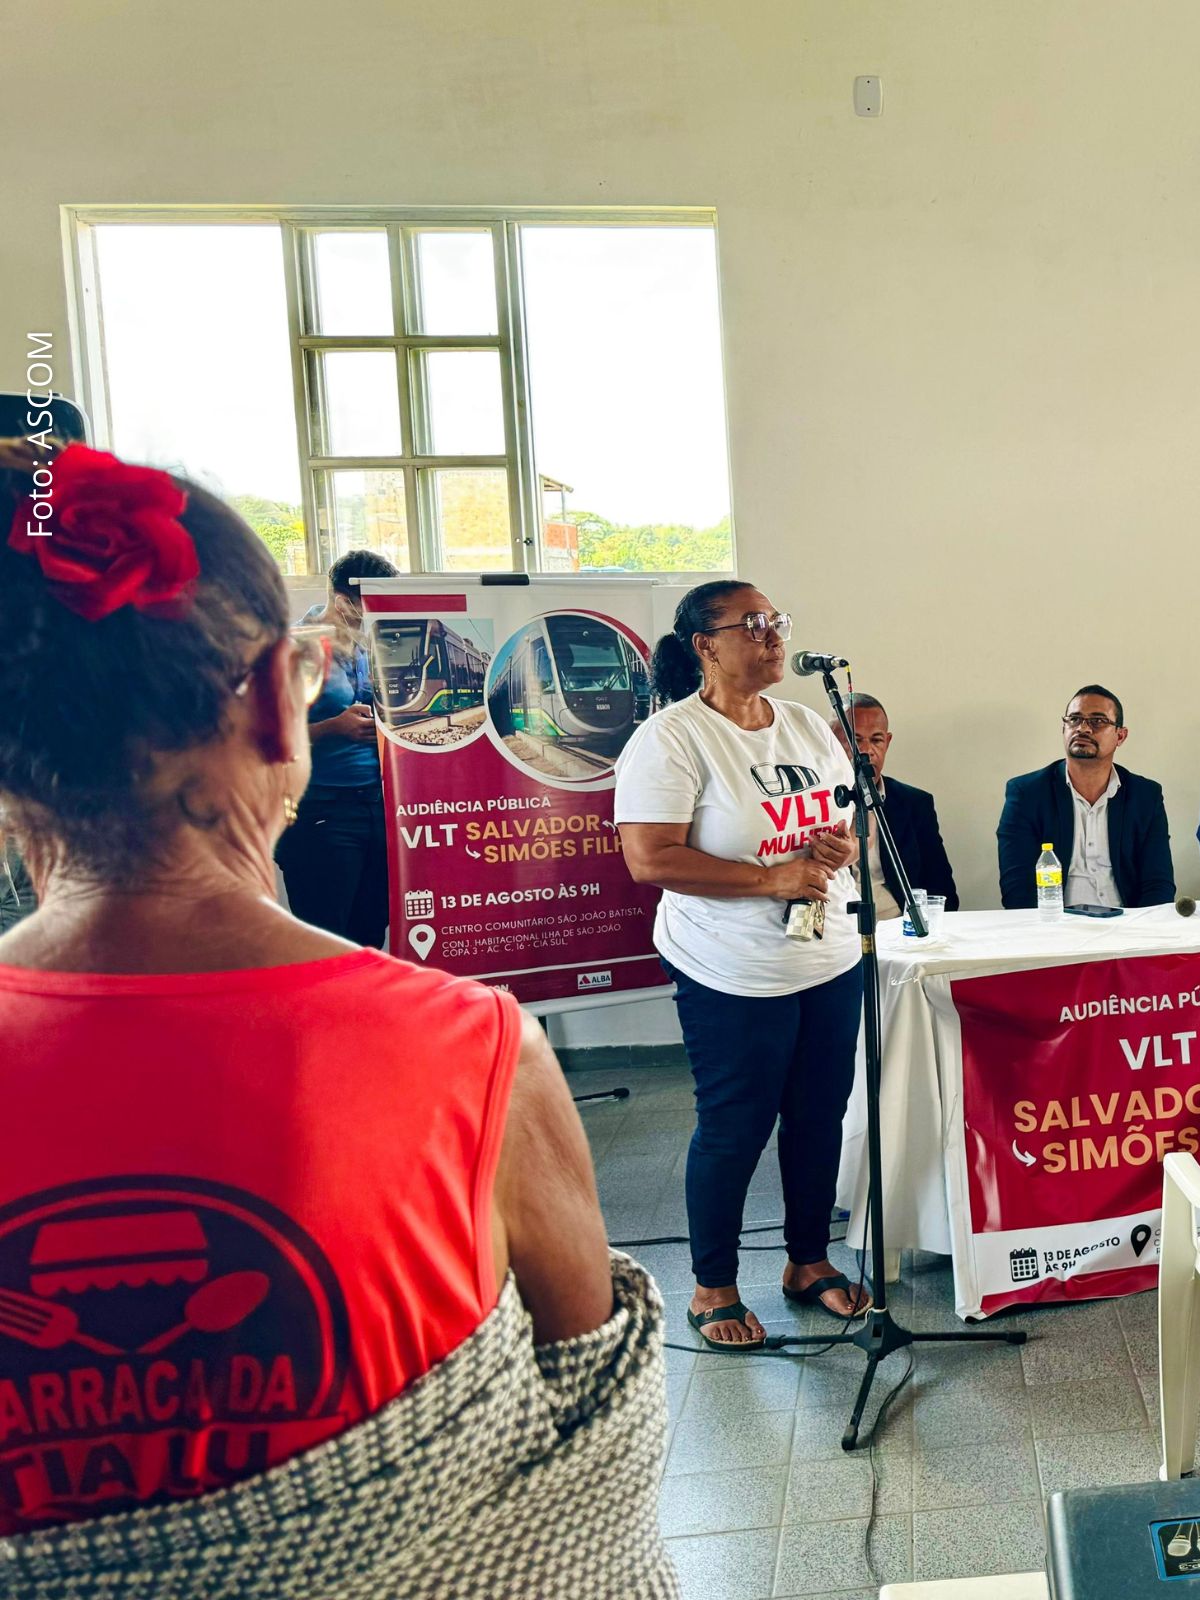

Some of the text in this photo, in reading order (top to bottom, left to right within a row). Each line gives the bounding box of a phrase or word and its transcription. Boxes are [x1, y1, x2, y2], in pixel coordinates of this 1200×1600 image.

[396, 796, 552, 817] AUDIÊNCIA PÚBLICA
[760, 790, 831, 832] VLT
[400, 815, 600, 849] VLT SALVADOR
[483, 837, 578, 864] SIMÕES
[440, 882, 601, 909] 13 DE AGOSTO ÀS 9H
[440, 923, 483, 935] CENTRO
[484, 916, 555, 932] COMUNITÁRIO
[474, 932, 540, 947] HABITACIONAL
[541, 930, 561, 940] ILHA
[562, 928, 575, 938] DE
[442, 947, 471, 959] COPA
[472, 946, 479, 956] 3
[516, 941, 526, 951] 16
[533, 939, 549, 949] CIA
[591, 975, 611, 984] ALBA
[1059, 993, 1174, 1023] AUDIÊNCIA
[1118, 1030, 1198, 1071] VLT
[1042, 1123, 1200, 1174] SIMÕES
[1043, 1236, 1121, 1262] 13 DE AGOSTO
[229, 1354, 297, 1413] DA
